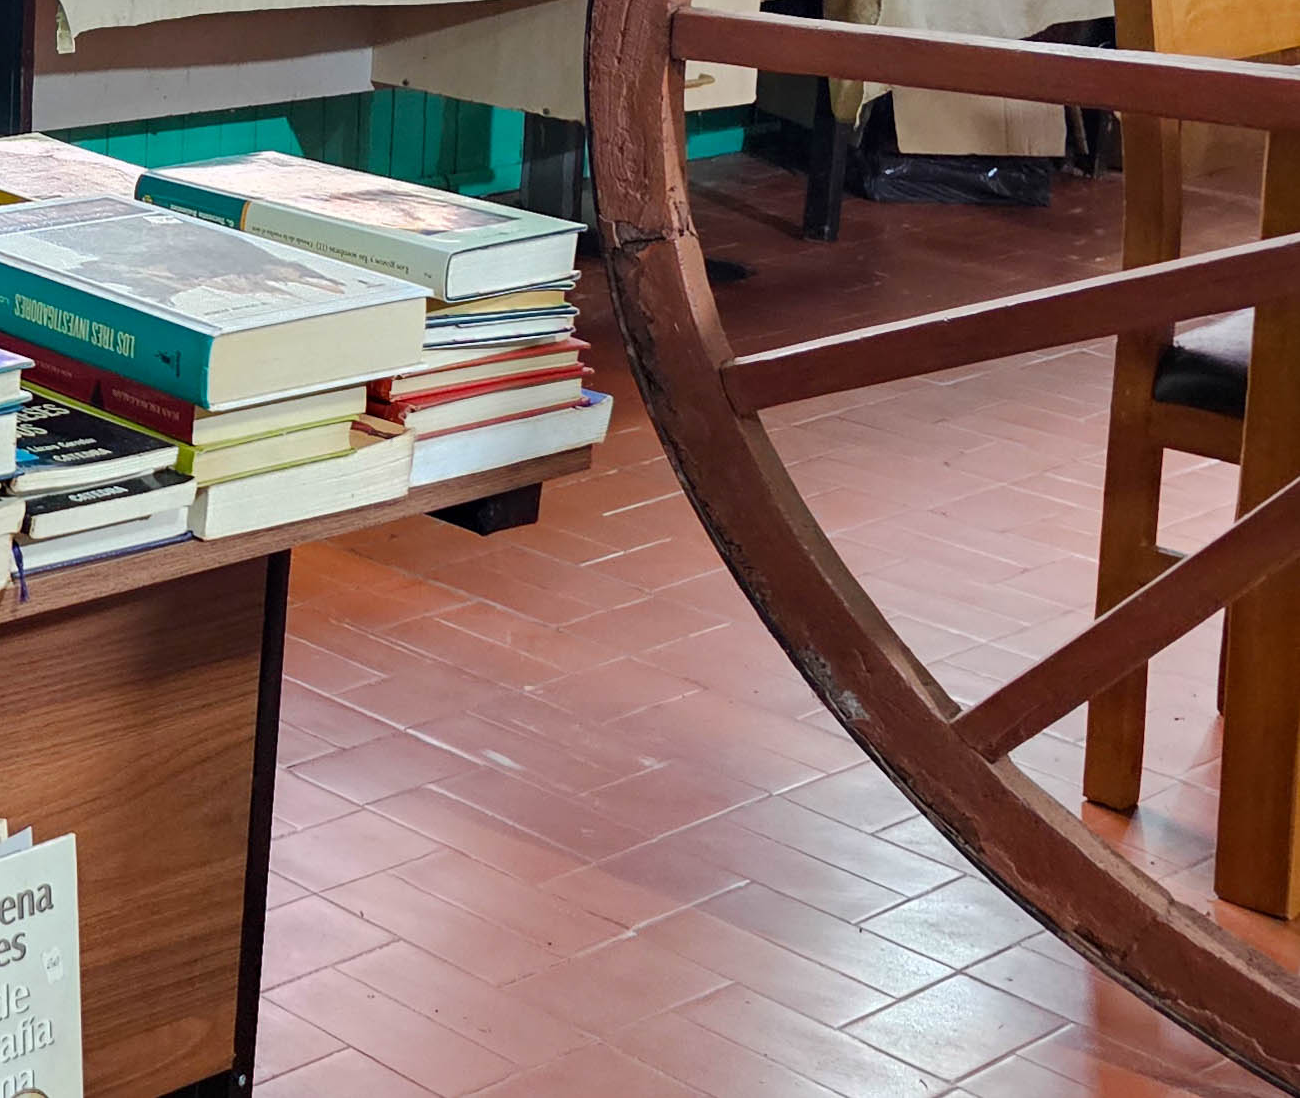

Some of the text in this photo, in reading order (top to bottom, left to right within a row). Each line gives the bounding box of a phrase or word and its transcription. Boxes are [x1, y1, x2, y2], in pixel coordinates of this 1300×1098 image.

[13, 293, 135, 358] LOS TRES INVESTIGADORES
